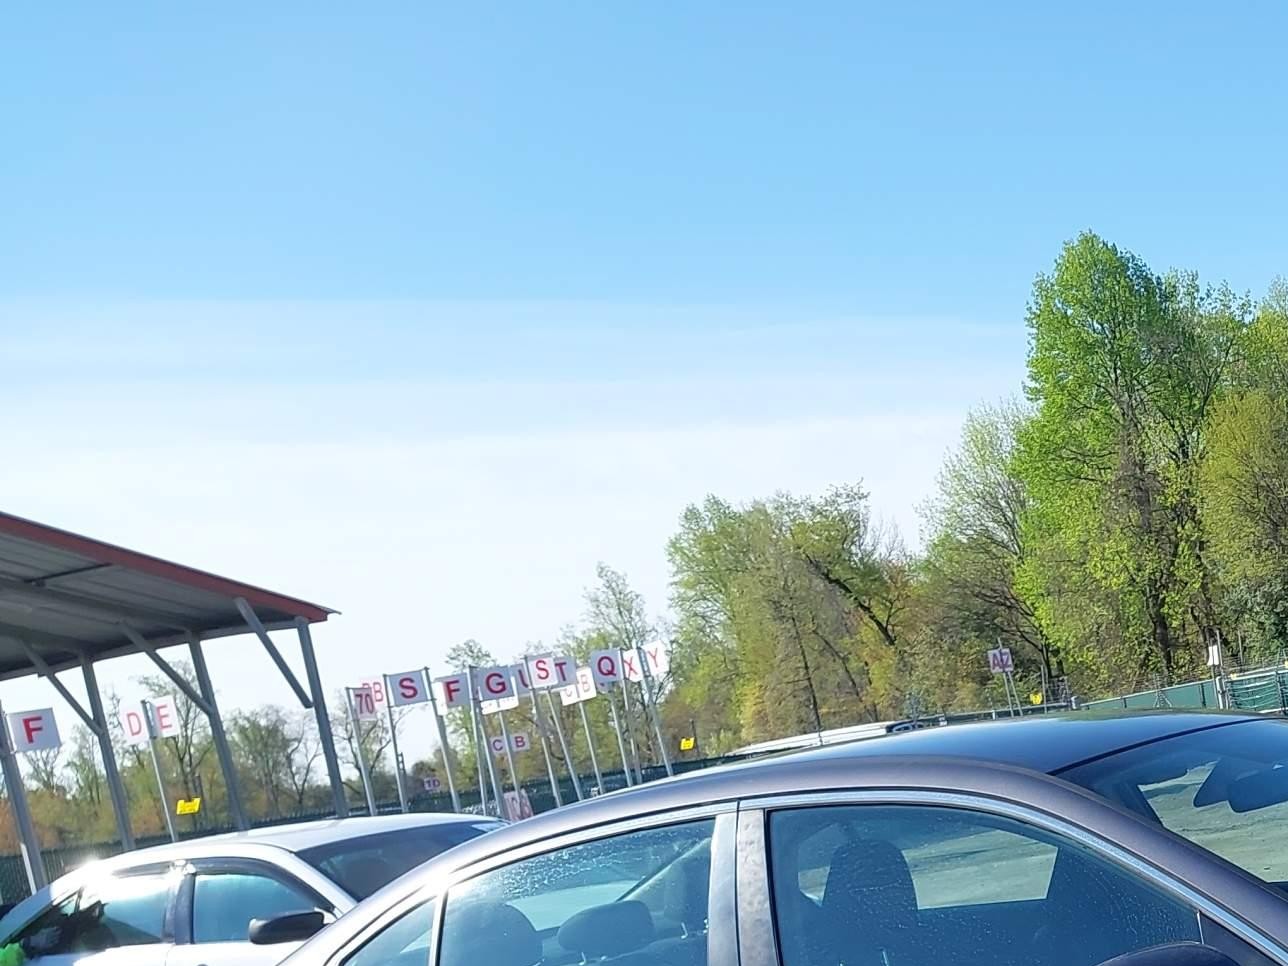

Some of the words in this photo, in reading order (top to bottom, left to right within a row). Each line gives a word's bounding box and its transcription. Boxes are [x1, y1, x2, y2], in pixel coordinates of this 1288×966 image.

[597, 656, 617, 677] Q
[623, 656, 639, 680] X
[648, 647, 659, 668] Y
[535, 660, 550, 680] S
[554, 662, 568, 682] T
[398, 677, 418, 699] S
[445, 680, 460, 702] F
[485, 672, 507, 694] G
[127, 711, 142, 736] D
[156, 704, 173, 730] E
[22, 715, 43, 744] F
[492, 739, 504, 751] C
[514, 735, 526, 748] B
